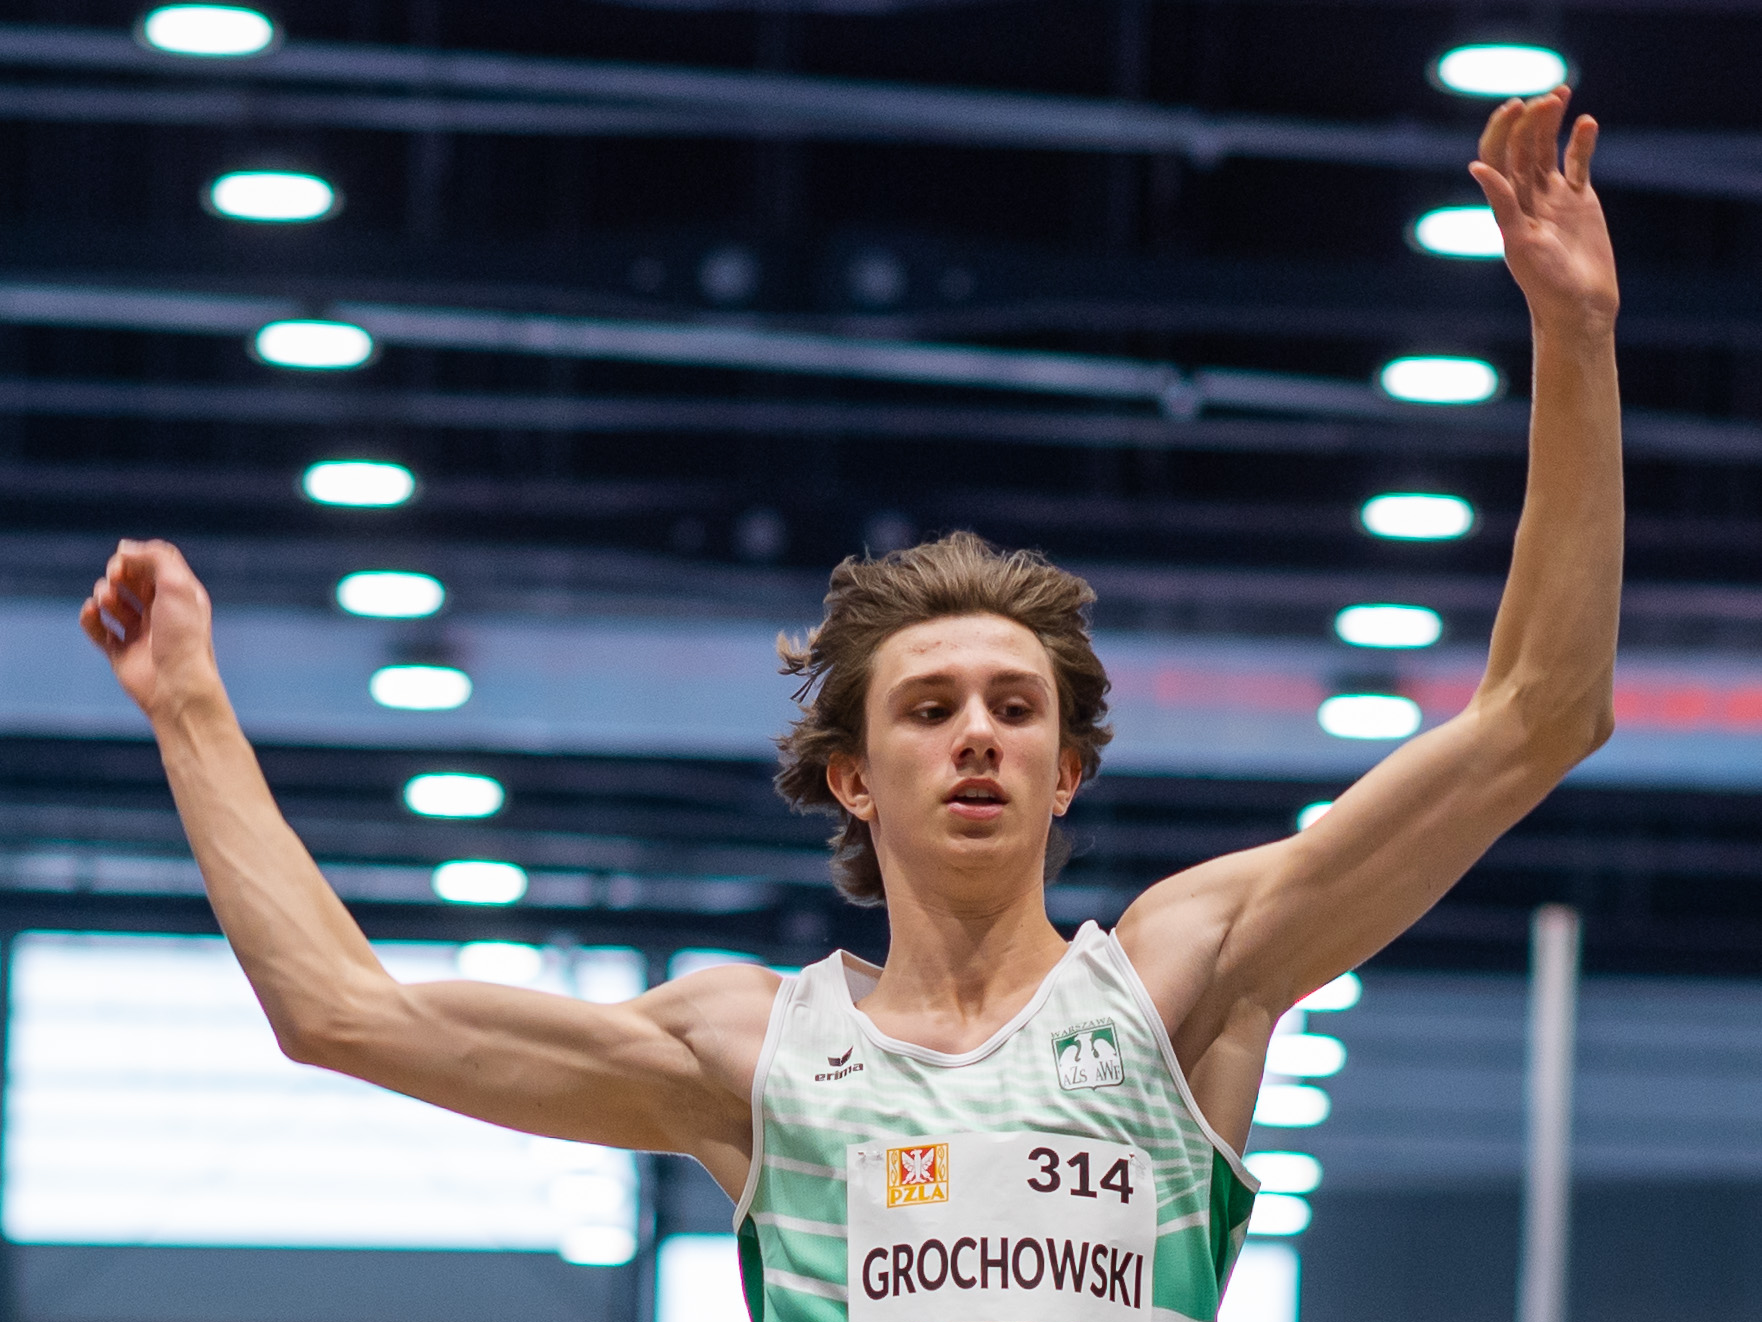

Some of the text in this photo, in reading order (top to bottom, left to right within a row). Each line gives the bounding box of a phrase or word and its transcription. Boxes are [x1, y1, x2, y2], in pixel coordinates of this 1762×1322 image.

[1050, 1016, 1114, 1038] WARSZAWA
[814, 1063, 864, 1082] erima
[1063, 1060, 1120, 1086] AZS AWF
[1027, 1146, 1134, 1204] 314
[890, 1184, 945, 1204] PZLA
[862, 1236, 1144, 1309] GROCHOWSKI
